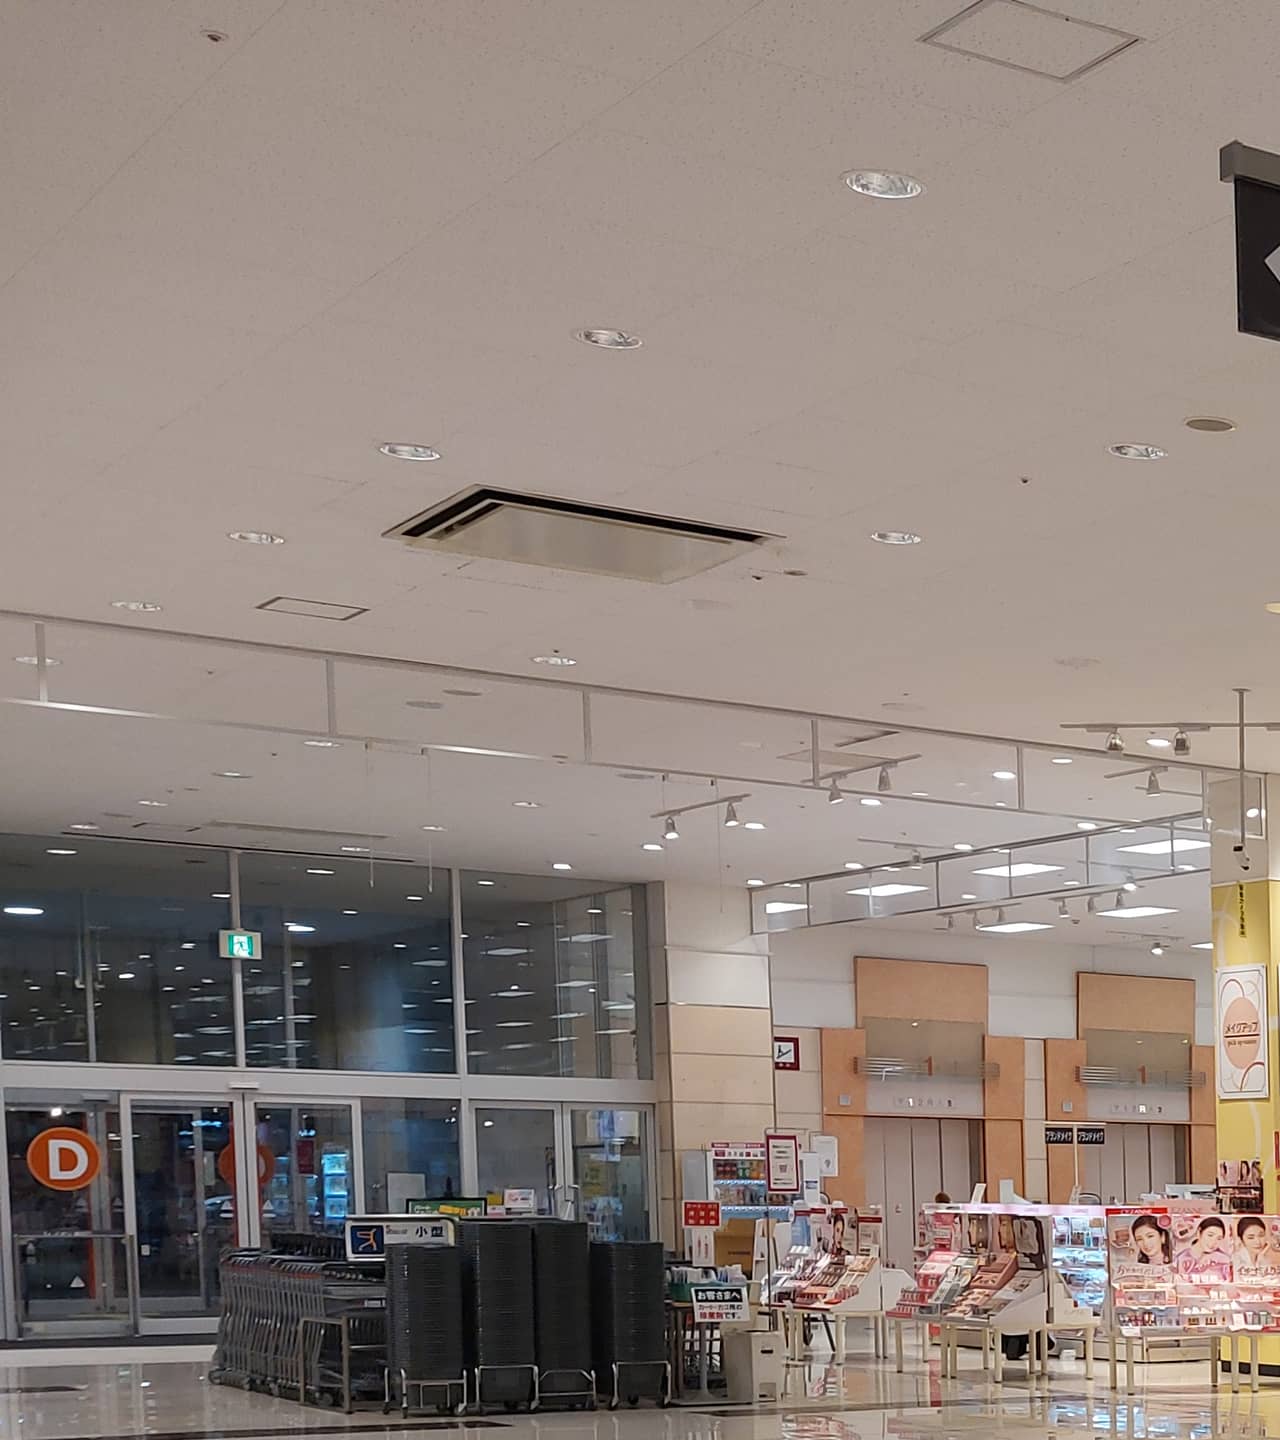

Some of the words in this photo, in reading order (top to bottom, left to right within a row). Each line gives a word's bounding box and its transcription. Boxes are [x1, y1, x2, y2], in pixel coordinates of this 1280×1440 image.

[1225, 1022, 1259, 1034] メイクアップ
[48, 1140, 88, 1180] D
